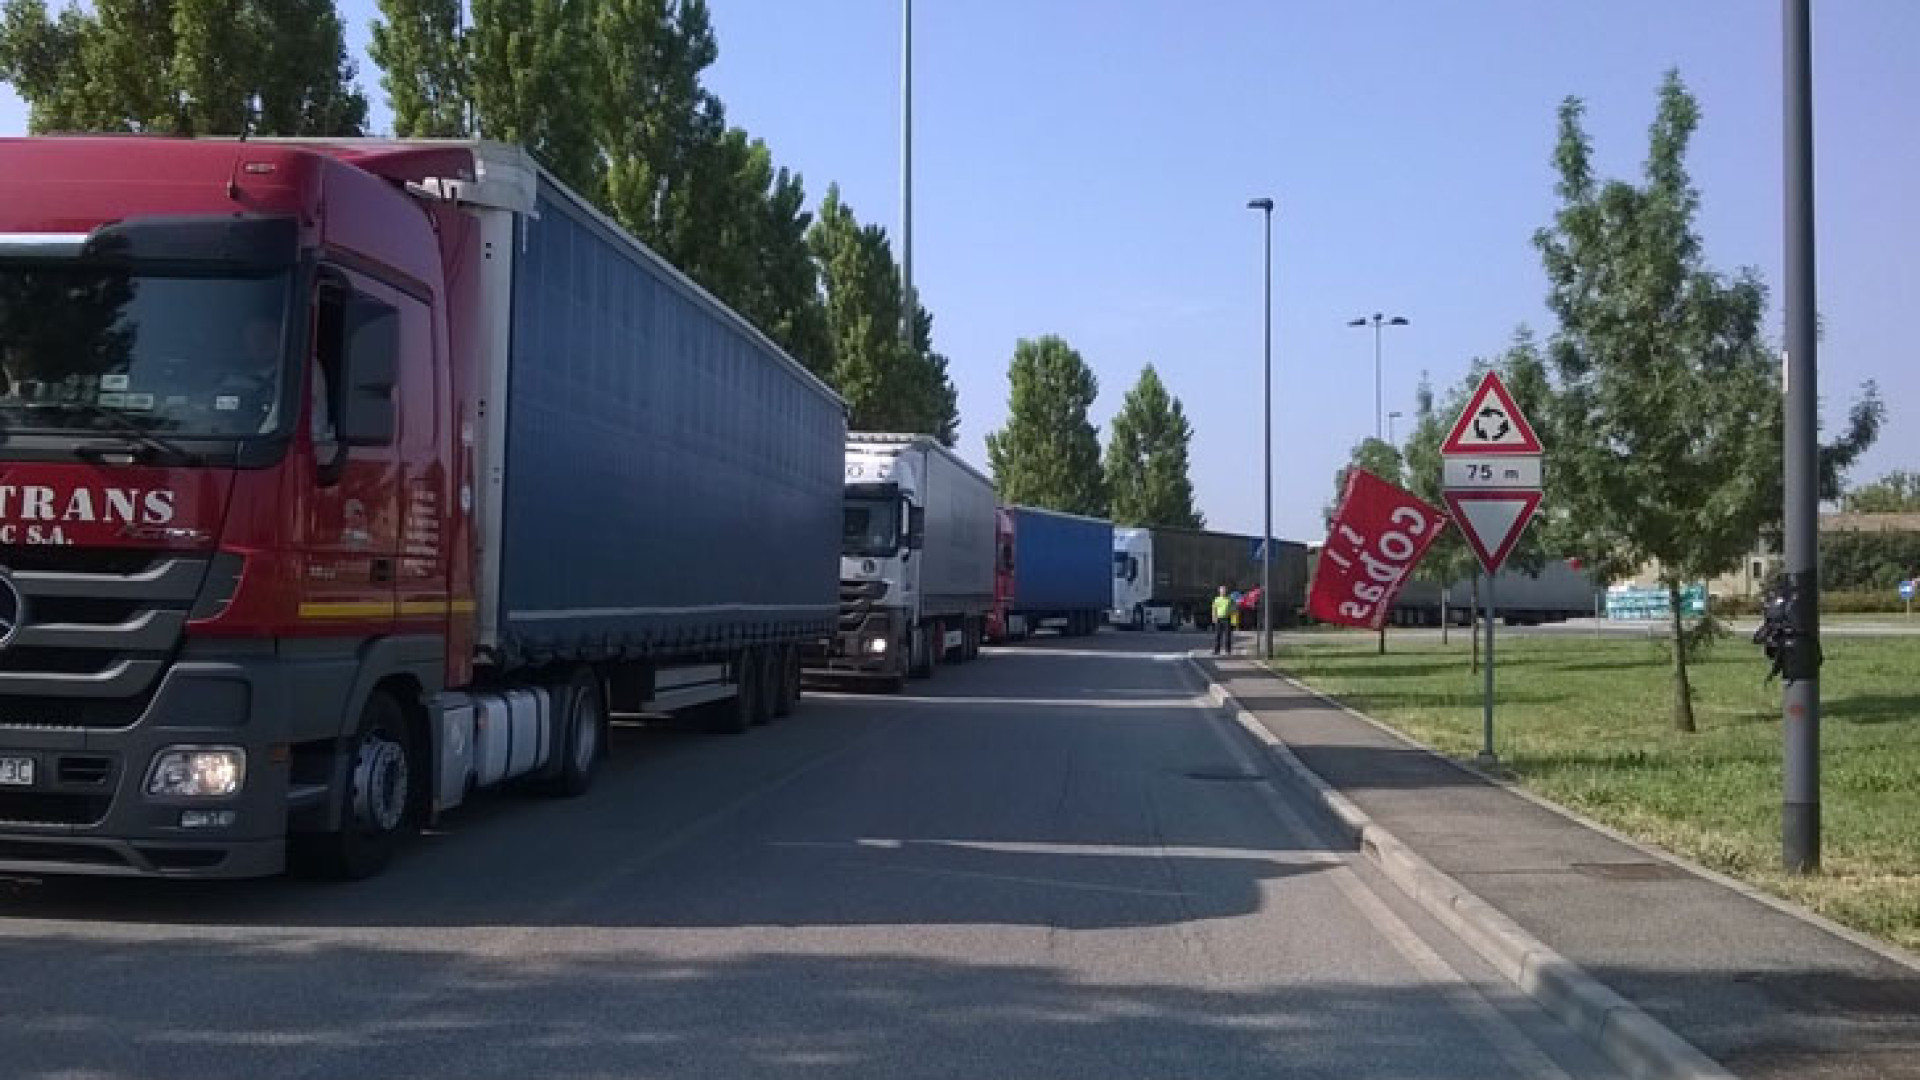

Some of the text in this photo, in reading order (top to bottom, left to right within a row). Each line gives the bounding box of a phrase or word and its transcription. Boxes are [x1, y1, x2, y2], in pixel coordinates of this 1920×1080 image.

[1466, 464, 1519, 482] 75 m
[0, 485, 175, 523] TRANS
